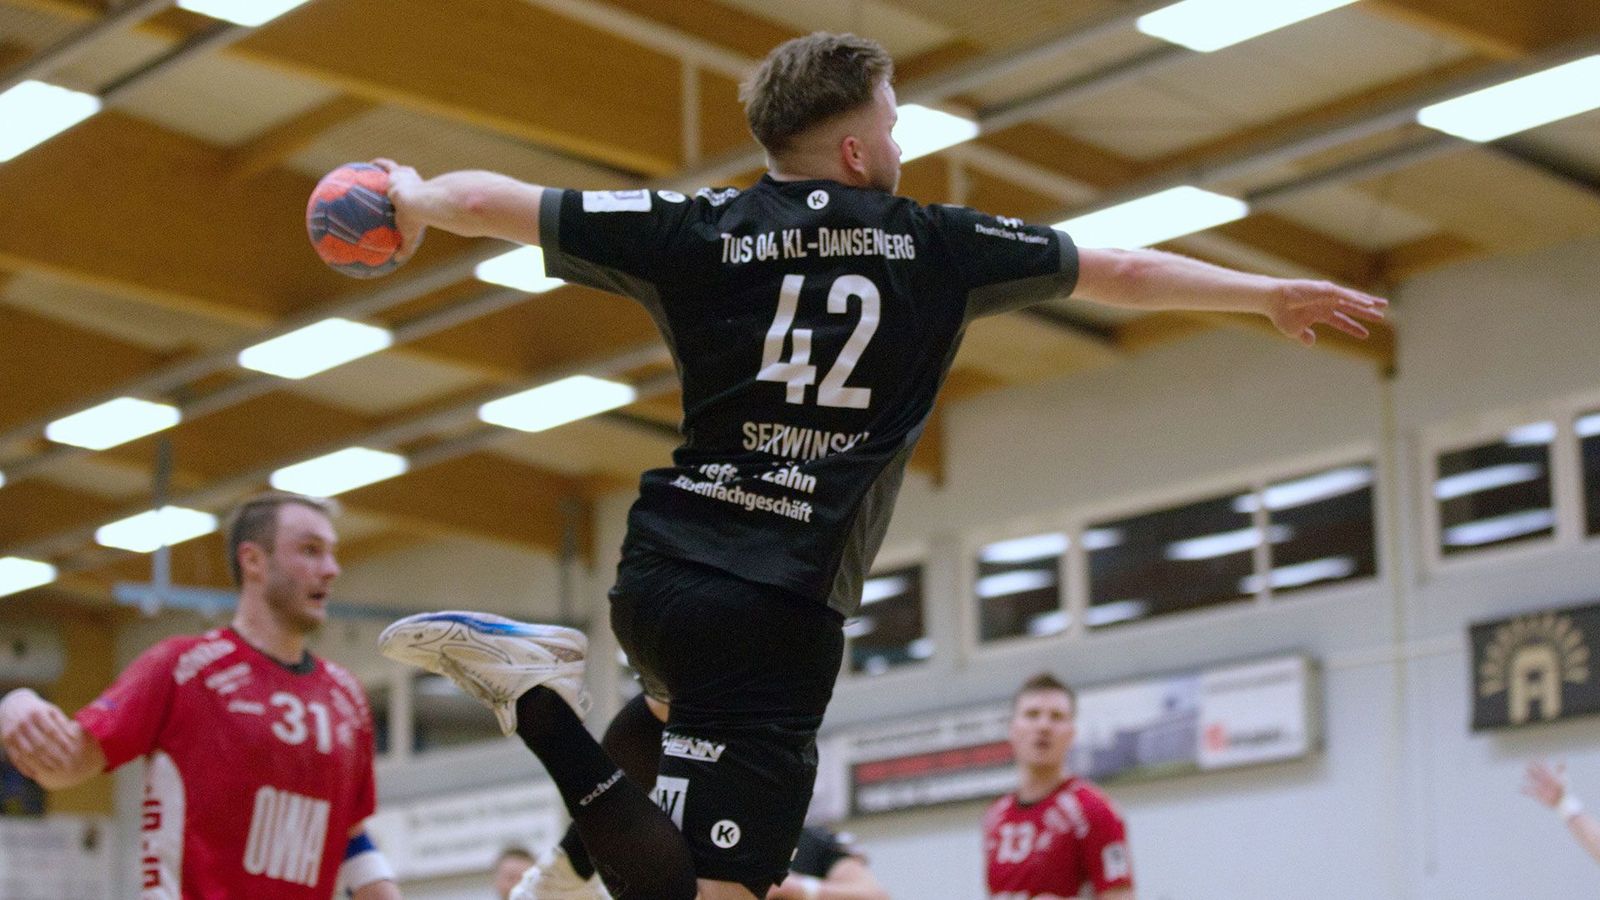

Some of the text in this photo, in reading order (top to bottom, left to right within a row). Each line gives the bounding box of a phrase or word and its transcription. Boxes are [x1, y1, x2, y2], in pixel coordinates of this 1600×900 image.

[757, 231, 779, 261] 04
[756, 274, 881, 409] 42
[269, 691, 331, 755] 31
[242, 784, 332, 889] OWA
